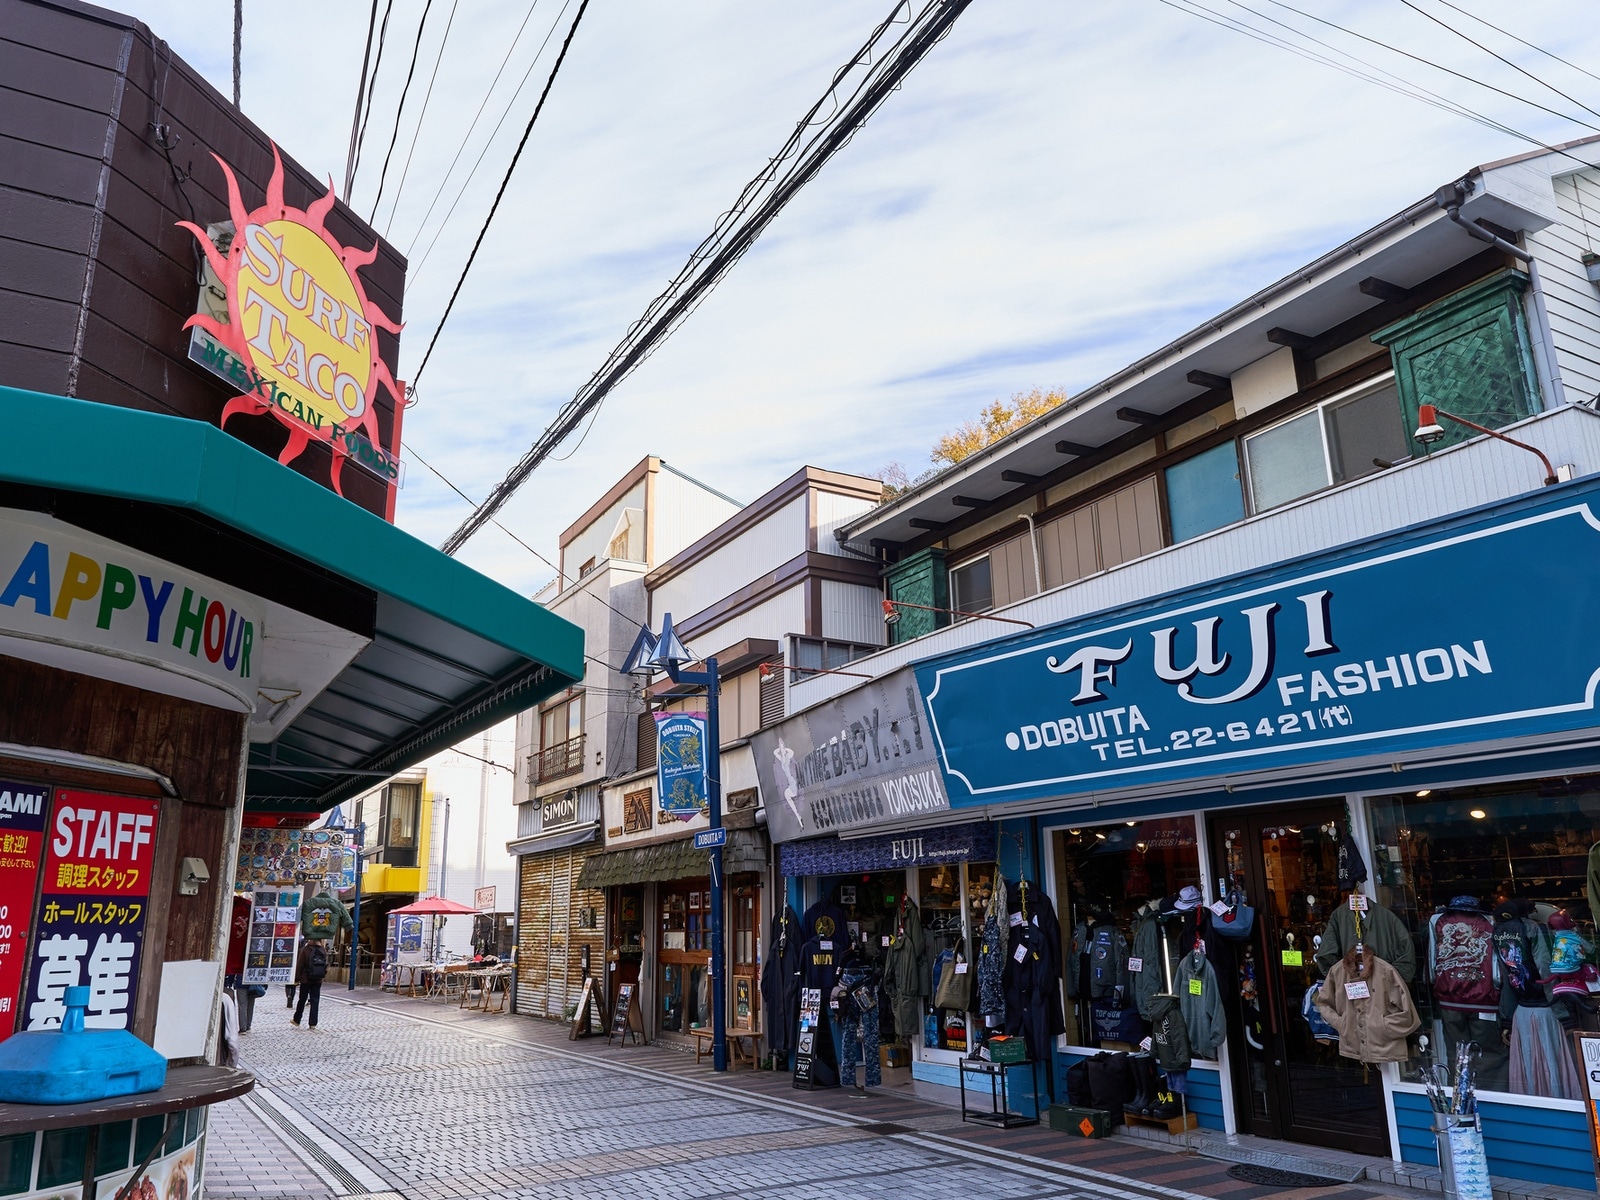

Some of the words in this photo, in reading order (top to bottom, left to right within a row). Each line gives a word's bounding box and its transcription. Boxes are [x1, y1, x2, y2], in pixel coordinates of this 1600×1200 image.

[239, 223, 372, 353] SURF
[244, 286, 366, 418] TACO
[201, 338, 324, 430] MEXICAN
[331, 420, 398, 479] FOODS
[0, 541, 175, 643] APPY
[172, 586, 253, 678] HOUR
[1277, 640, 1493, 706] FASHION
[544, 799, 574, 821] SIMON
[882, 770, 945, 815] YOKOSUKA
[53, 806, 153, 860] STAFF
[698, 833, 718, 845] DOBUITA
[891, 837, 924, 862] FUJI
[56, 863, 139, 889] 調理スタッフ
[43, 901, 142, 925] ホールスタッフ
[27, 933, 135, 1031] 募集
[813, 954, 833, 966] NAVY
[1095, 1009, 1107, 1018] TOP
